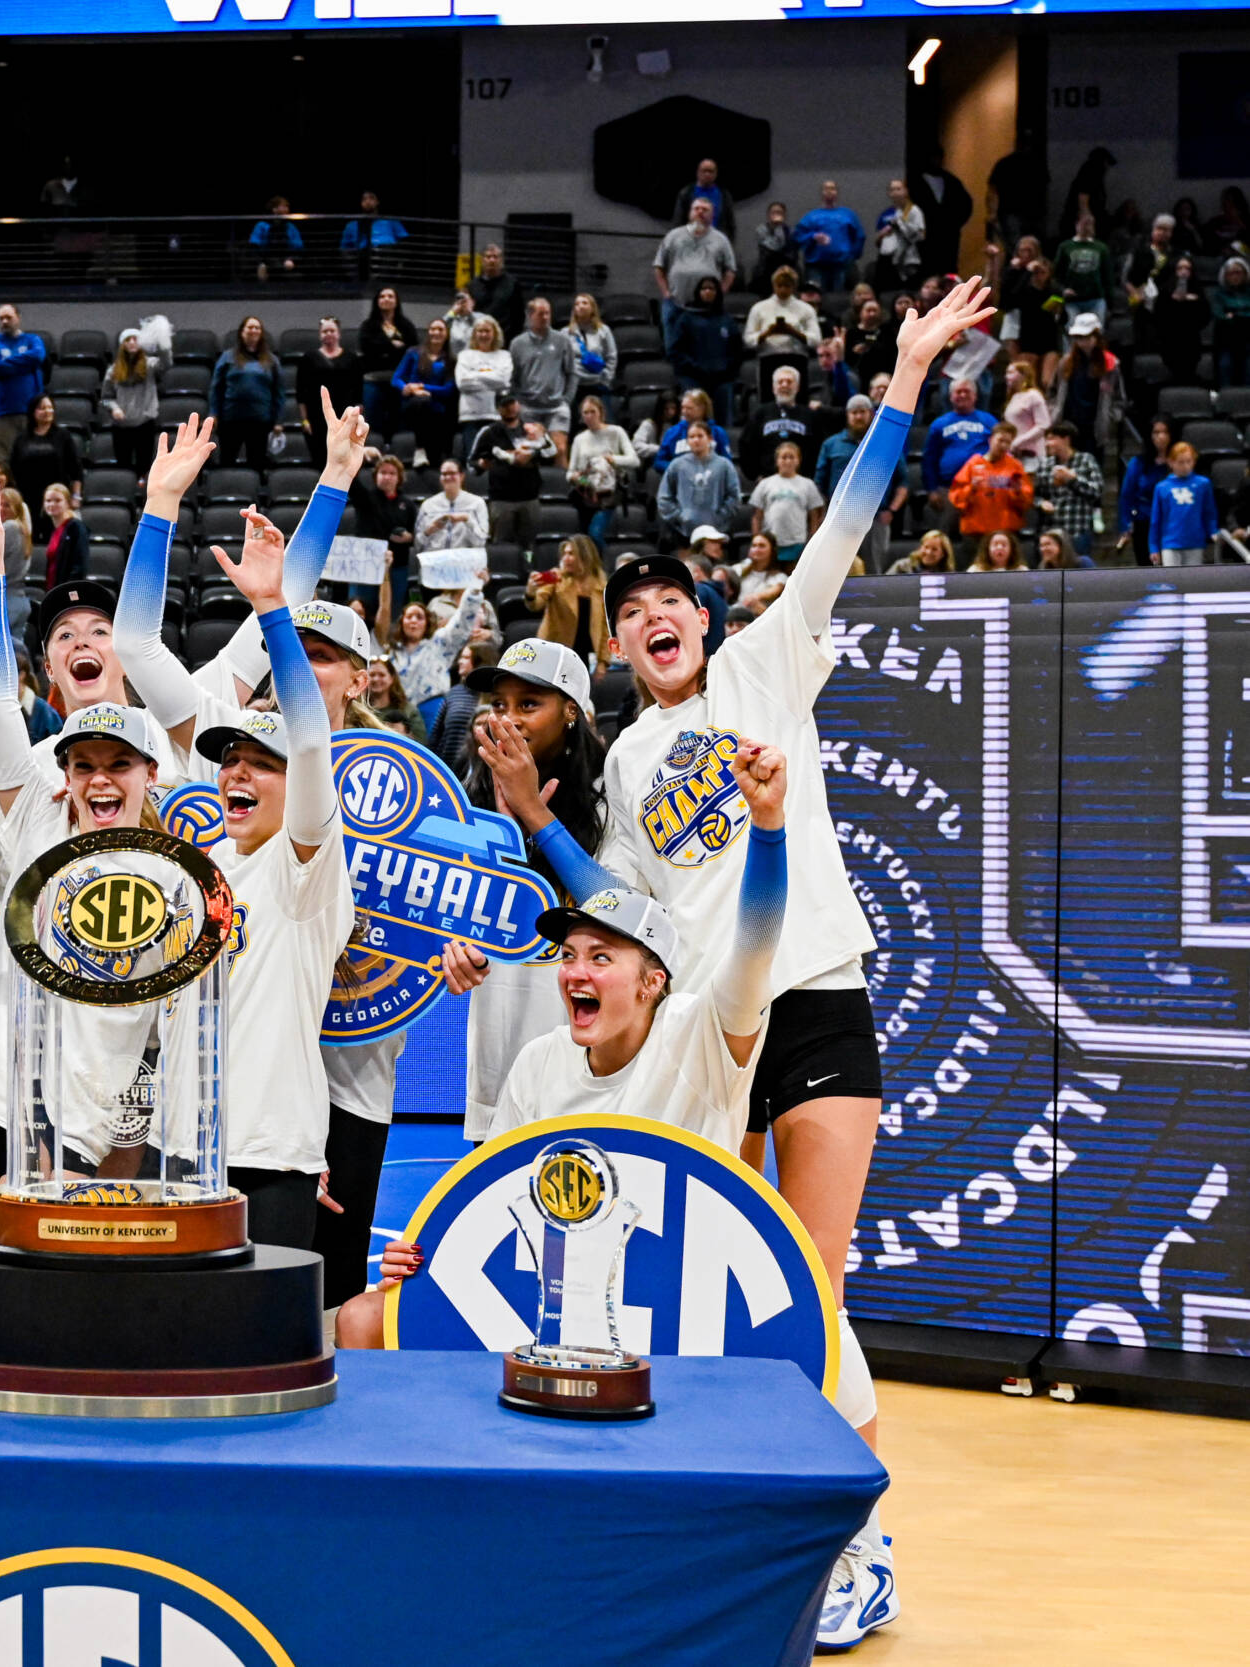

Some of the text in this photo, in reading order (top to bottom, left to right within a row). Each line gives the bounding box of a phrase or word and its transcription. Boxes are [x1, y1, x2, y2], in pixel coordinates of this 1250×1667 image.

[466, 79, 512, 99] 107
[1052, 86, 1100, 108] 108
[1171, 486, 1194, 505] UK
[79, 716, 125, 730] CHAMPS
[344, 758, 404, 823] SEC
[646, 779, 686, 808] VOLLEYBALL
[349, 841, 518, 934] EYBALL
[835, 821, 936, 940] ENTUCKY
[78, 880, 158, 943] SEC
[352, 891, 515, 946] NAMENT
[332, 988, 411, 1024] GEORGIA
[544, 1160, 591, 1213] SEC
[48, 1225, 168, 1237] UNIVERSITY OF KENTUCKY
